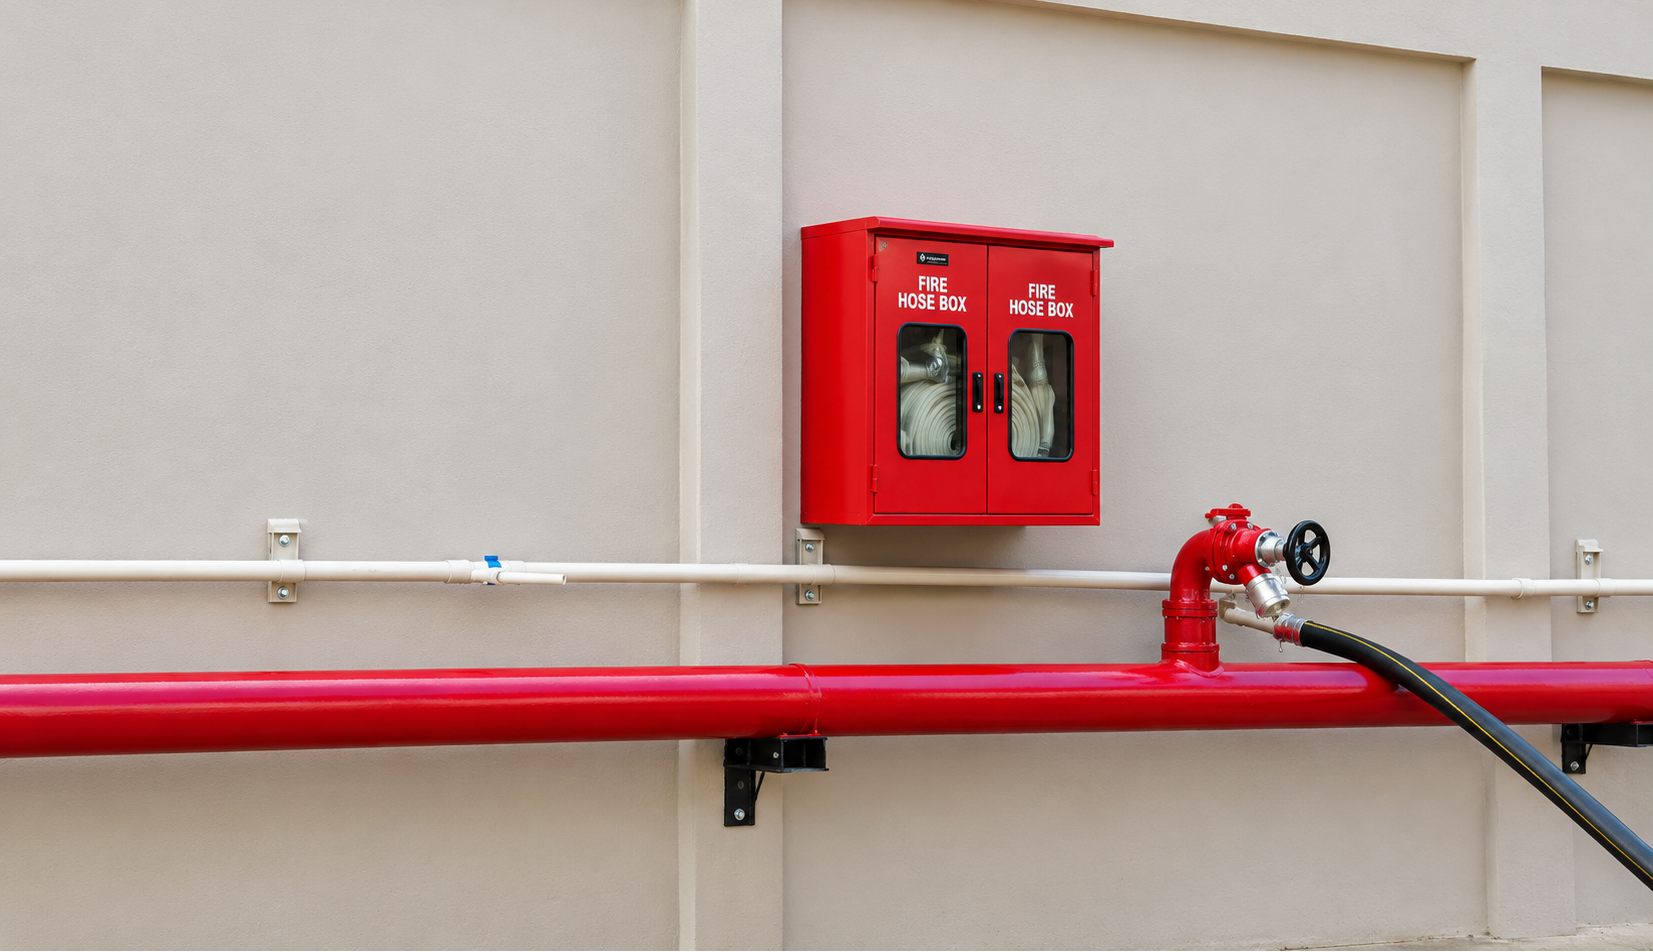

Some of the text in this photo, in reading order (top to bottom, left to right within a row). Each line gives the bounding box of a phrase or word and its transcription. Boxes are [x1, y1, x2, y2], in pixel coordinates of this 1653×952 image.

[918, 275, 948, 293] FIRE
[1028, 282, 1056, 300] FIRE
[898, 291, 967, 313] HOSE BOX
[1009, 298, 1074, 318] HOSE BOX
